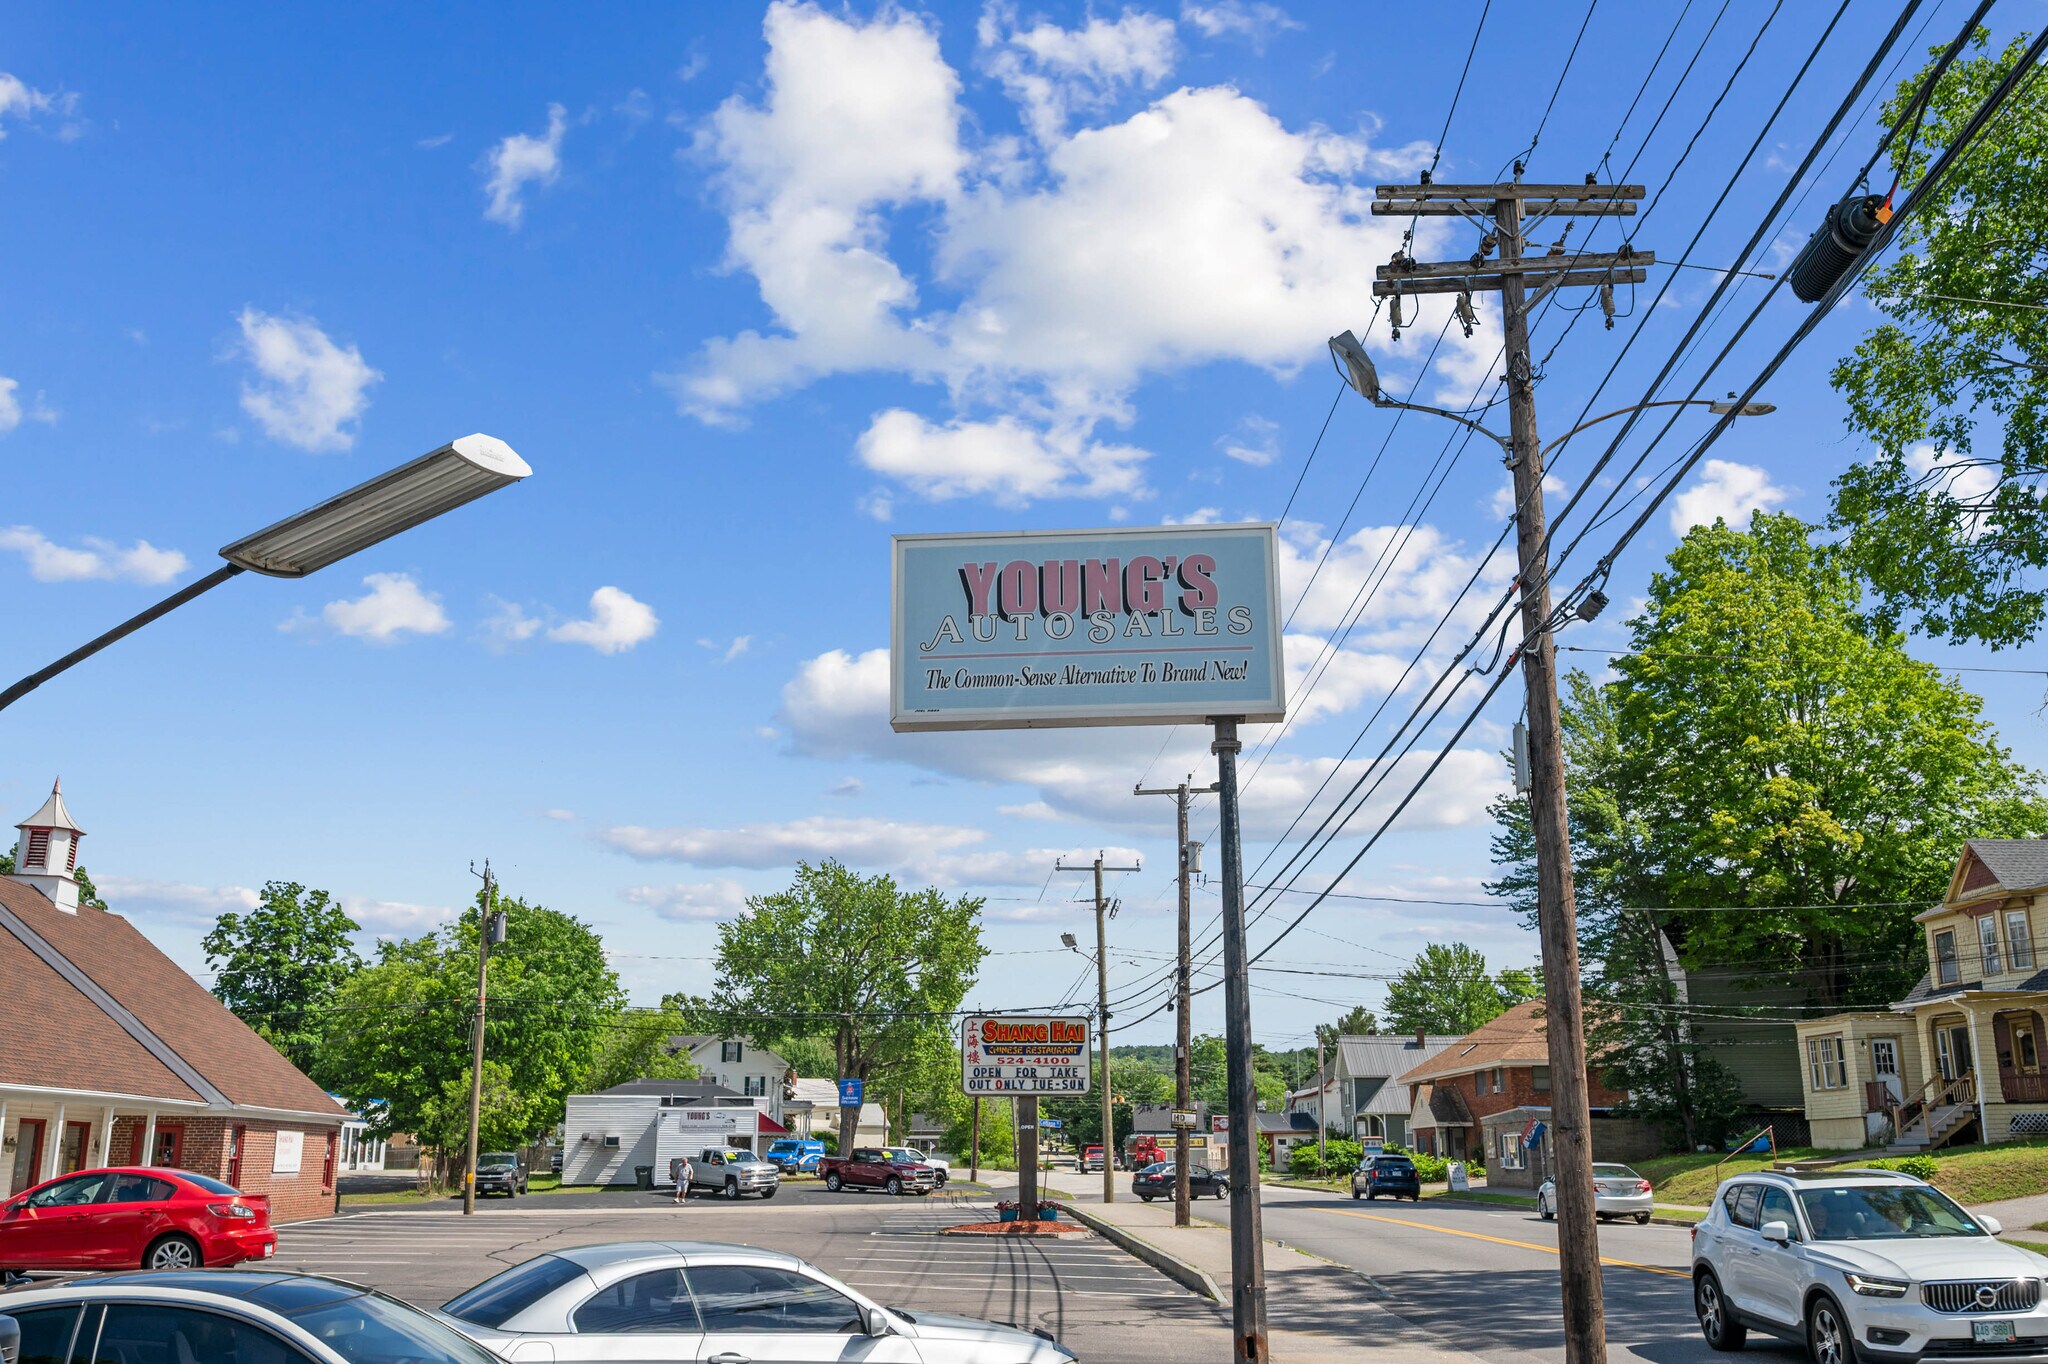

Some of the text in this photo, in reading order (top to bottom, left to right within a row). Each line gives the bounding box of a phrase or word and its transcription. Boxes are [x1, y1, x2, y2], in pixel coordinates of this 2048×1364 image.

[958, 554, 1219, 623] YOUNG'S
[926, 660, 1248, 690] The Common-Sense Alternative To Brand New!
[981, 1019, 1086, 1043] SHANG HAI
[988, 1046, 1078, 1055] CHINESE RESTAURANT
[996, 1057, 1070, 1065] 524-4100
[973, 1067, 1078, 1078] OPEN FOR TAKE
[969, 1079, 1085, 1090] OUT ONLY TUE-SUN
